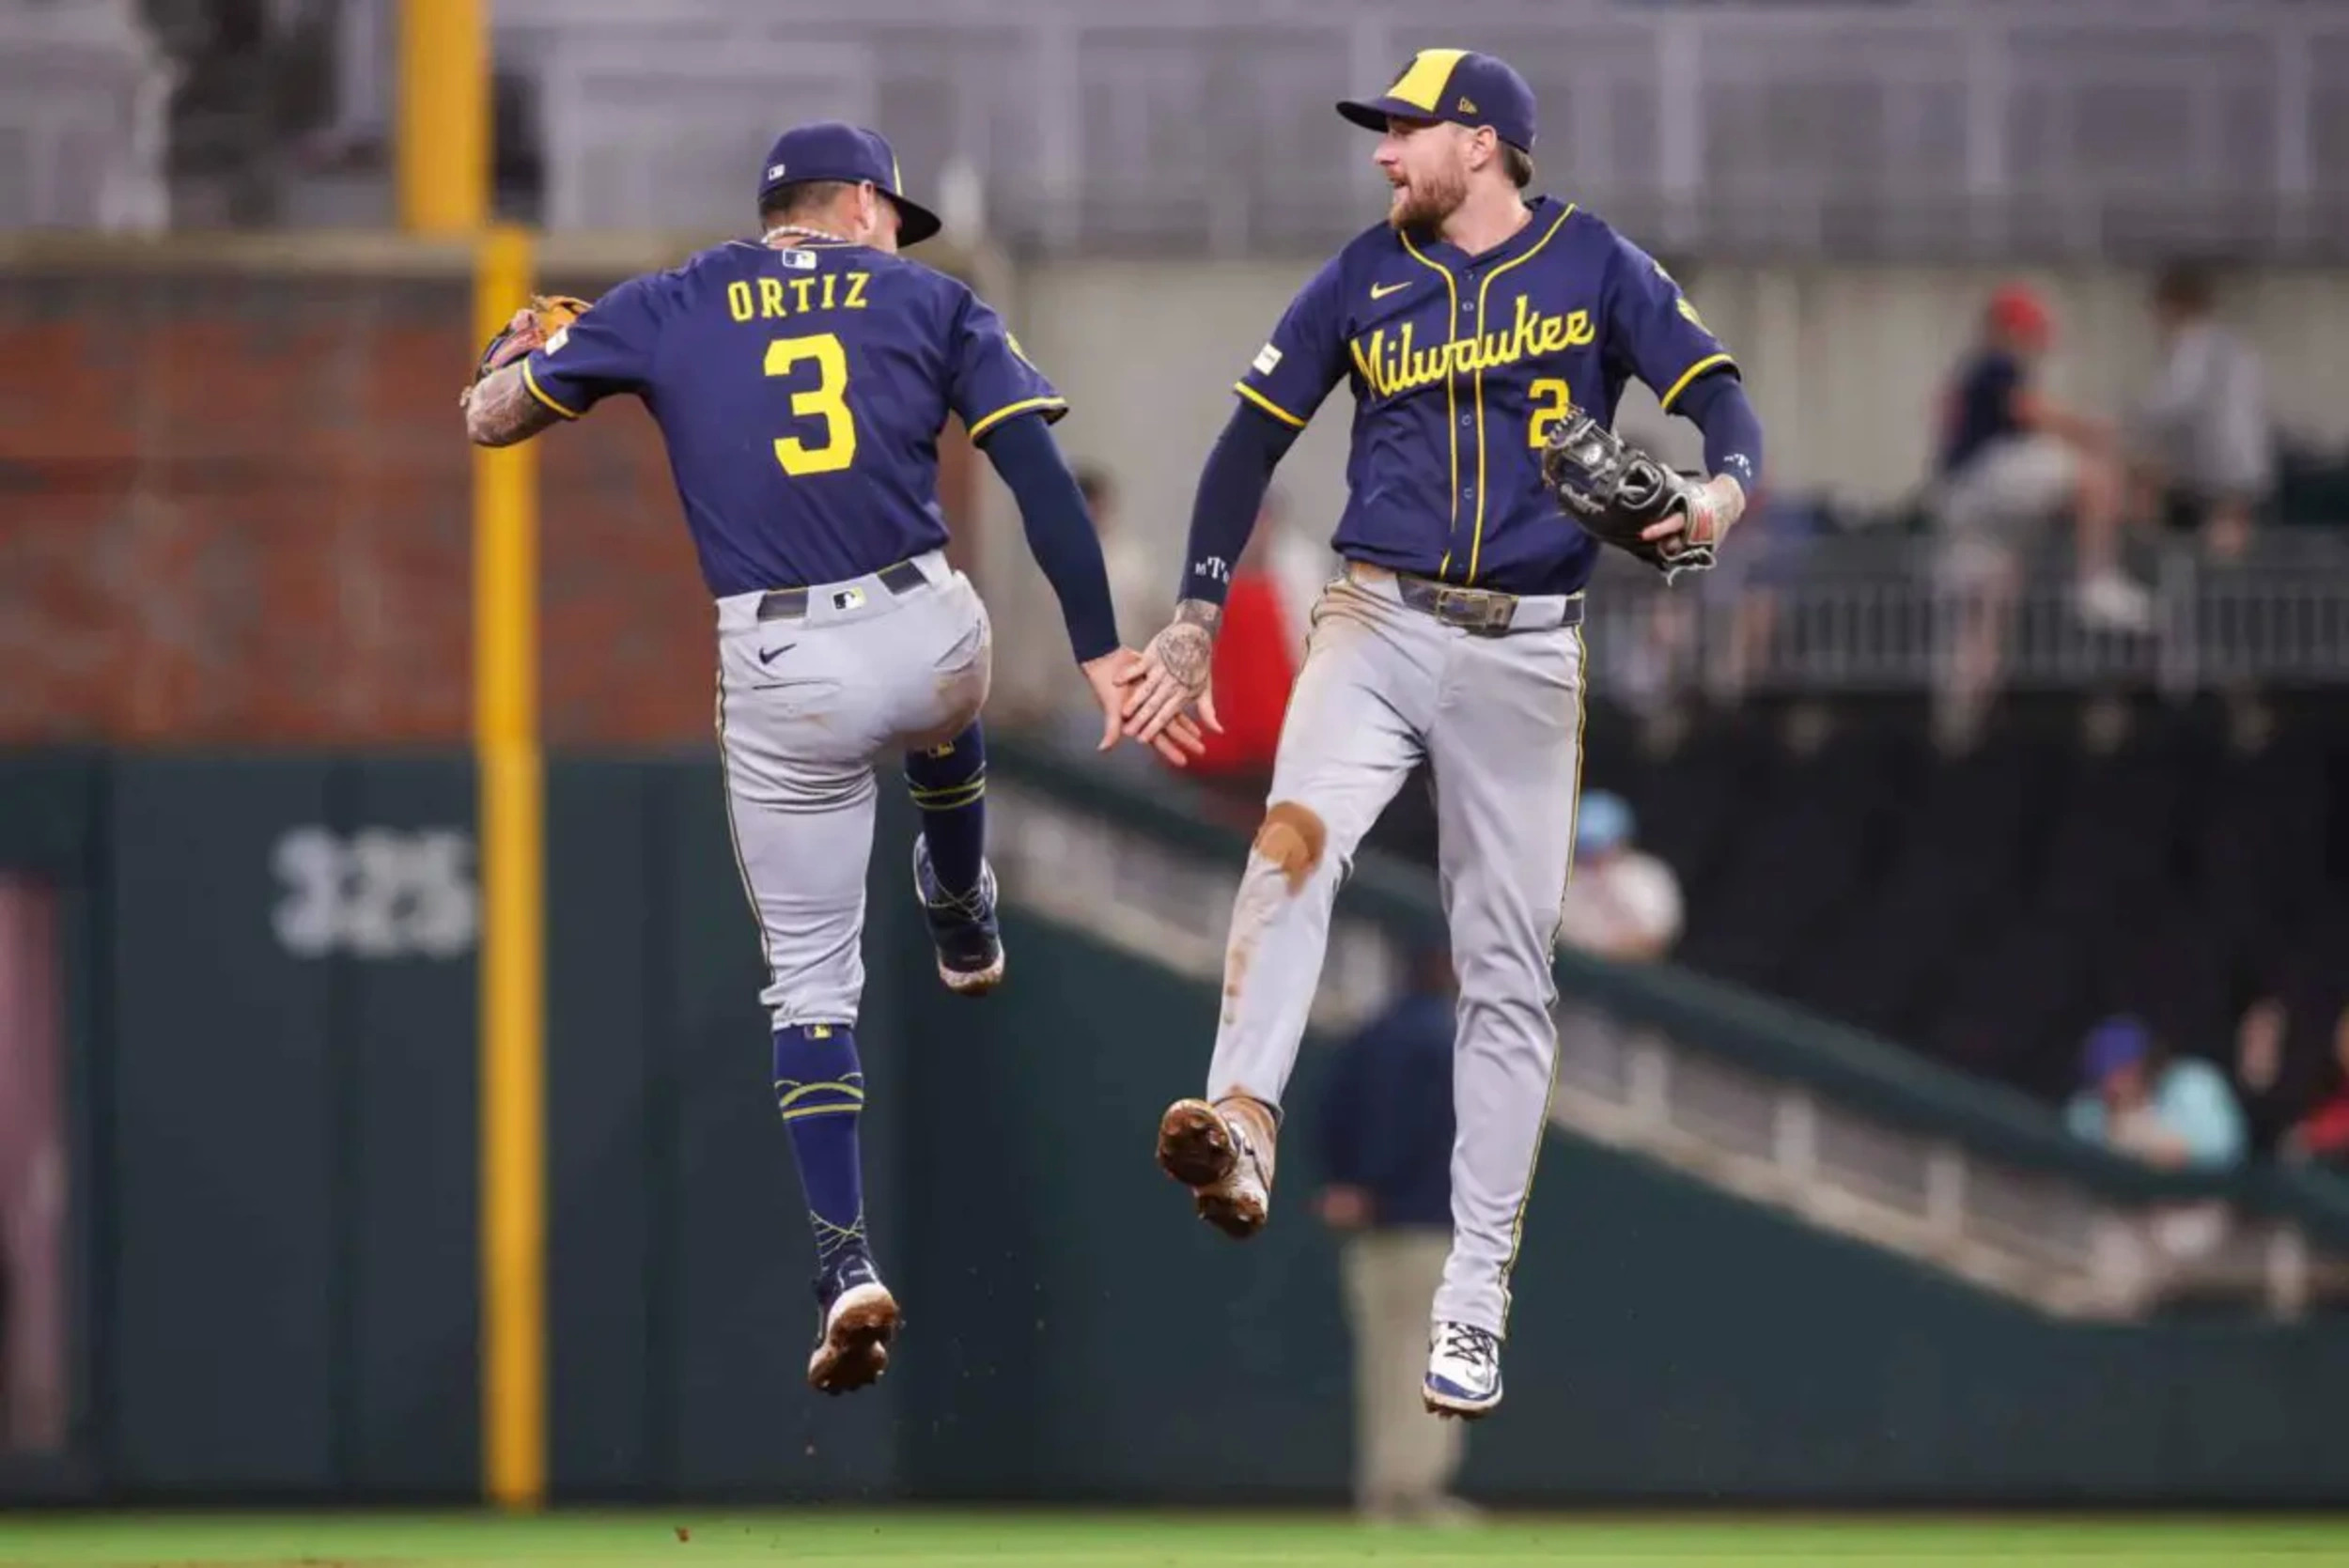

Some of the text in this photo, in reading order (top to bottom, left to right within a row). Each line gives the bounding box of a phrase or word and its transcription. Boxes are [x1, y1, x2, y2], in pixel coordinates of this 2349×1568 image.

[726, 272, 871, 321] ORTIZ
[1350, 294, 1595, 404] Milwaukee
[763, 332, 857, 476] 3
[1528, 378, 1571, 448] 2
[268, 823, 477, 960] 325
